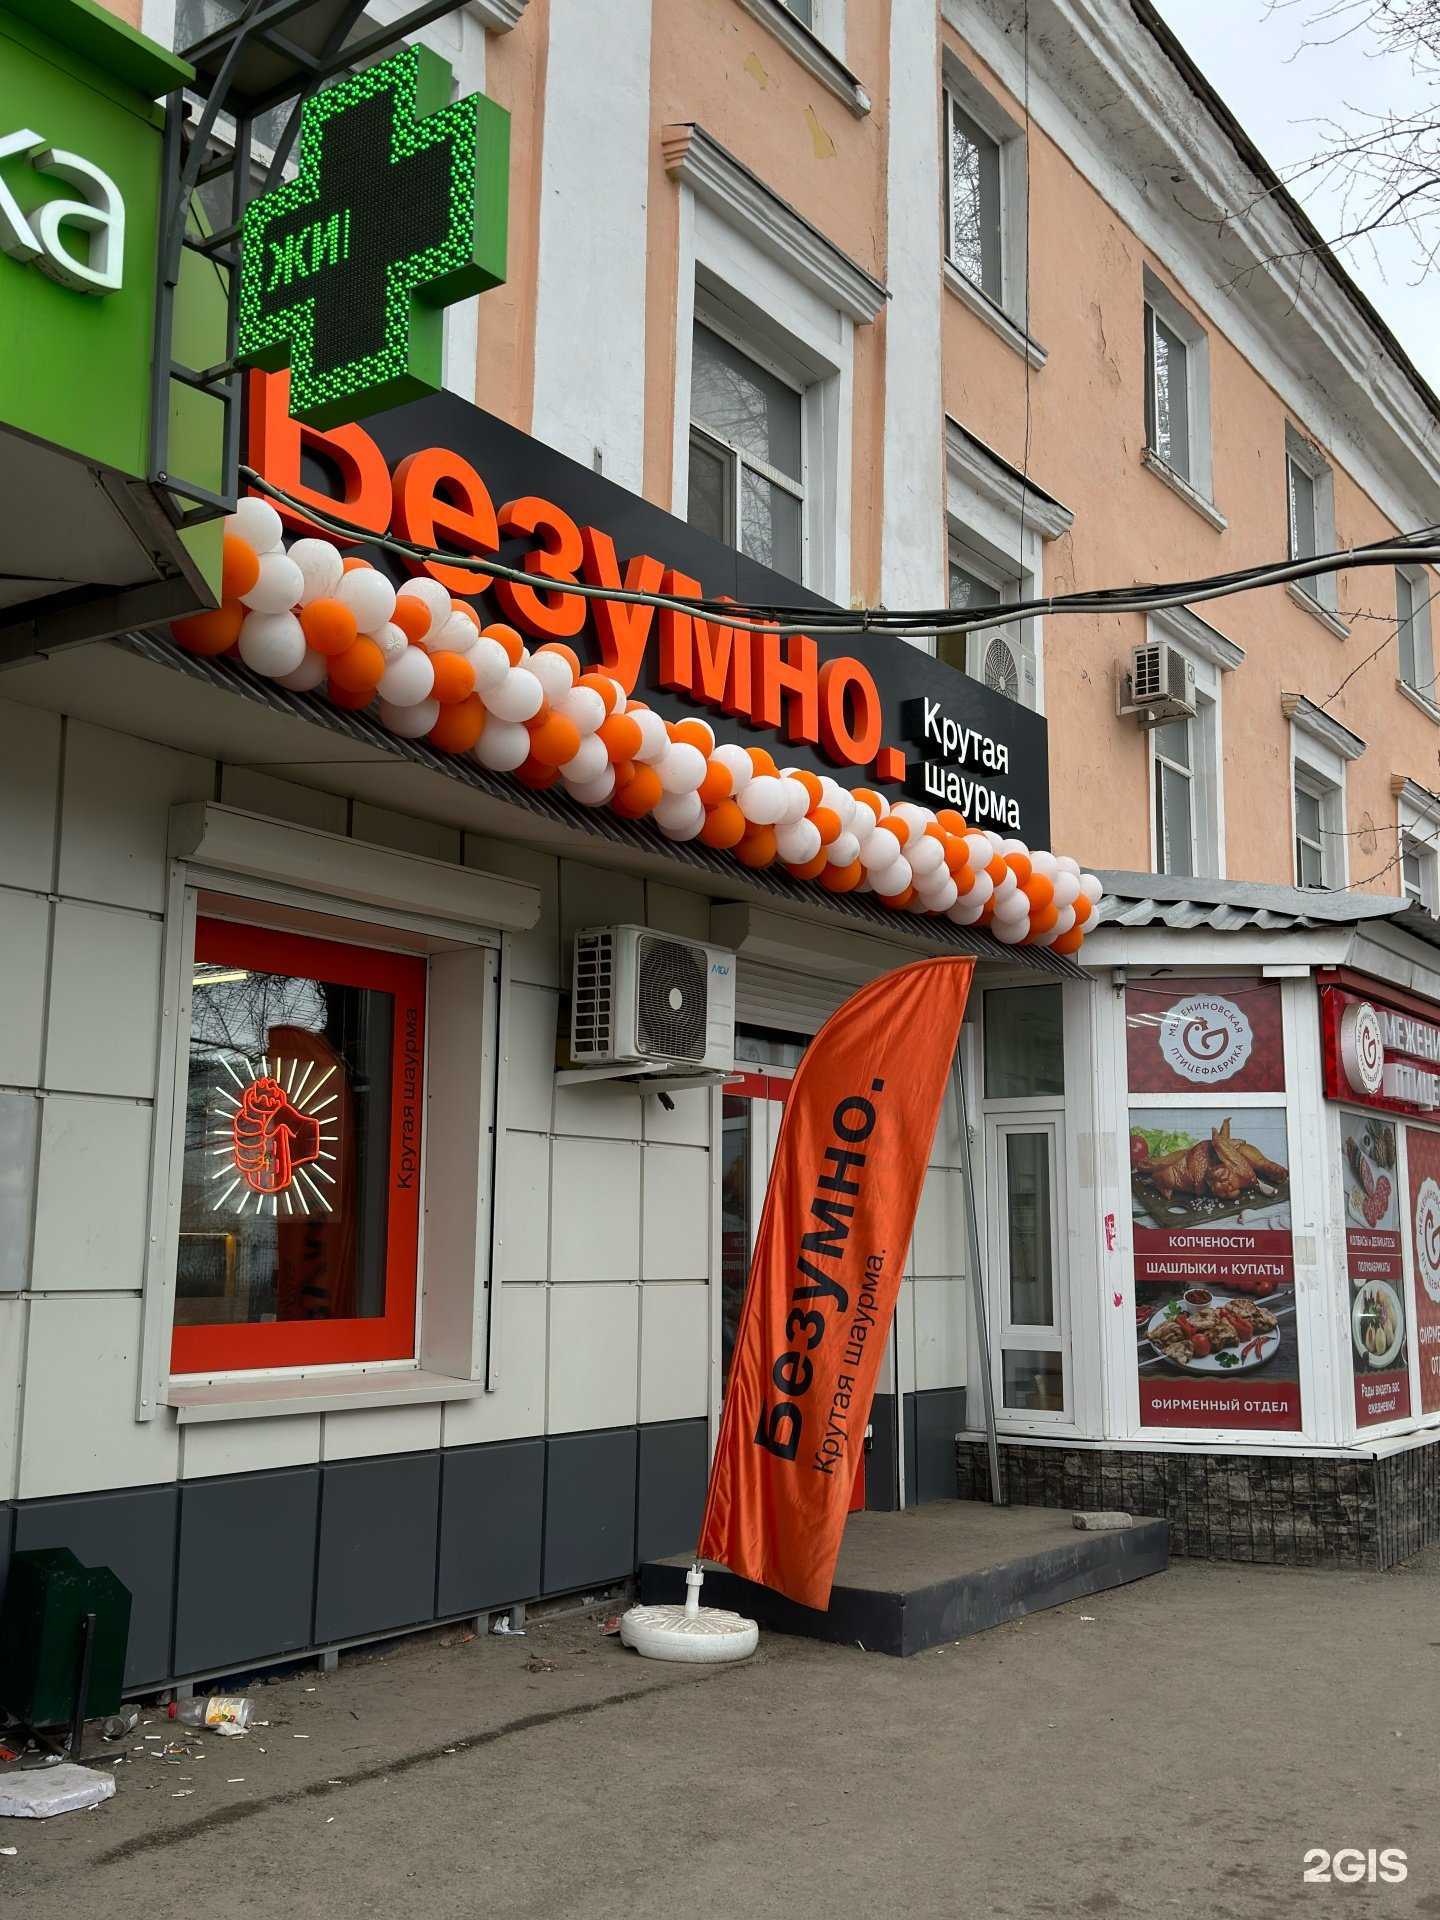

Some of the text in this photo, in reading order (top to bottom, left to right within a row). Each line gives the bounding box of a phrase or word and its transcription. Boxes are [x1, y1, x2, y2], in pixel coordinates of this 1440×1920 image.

[248, 367, 906, 783] Безумно.
[924, 696, 1009, 775] Крутая
[924, 761, 1021, 831] шаурма
[1170, 1043, 1244, 1075] ПТИЦЕФАБРИКА
[397, 1007, 420, 1189] Крутая шаурма
[754, 1077, 885, 1461] Безумно.
[1146, 1262, 1285, 1276] ШАШЛЫКИ и КУПАТЫ
[1168, 1236, 1255, 1249] КОПЧЕНОСТИ
[812, 1249, 886, 1475] Крутая шаурма.
[1151, 1398, 1288, 1413] ФИРМЕННЫЙ ОТДЕЛ
